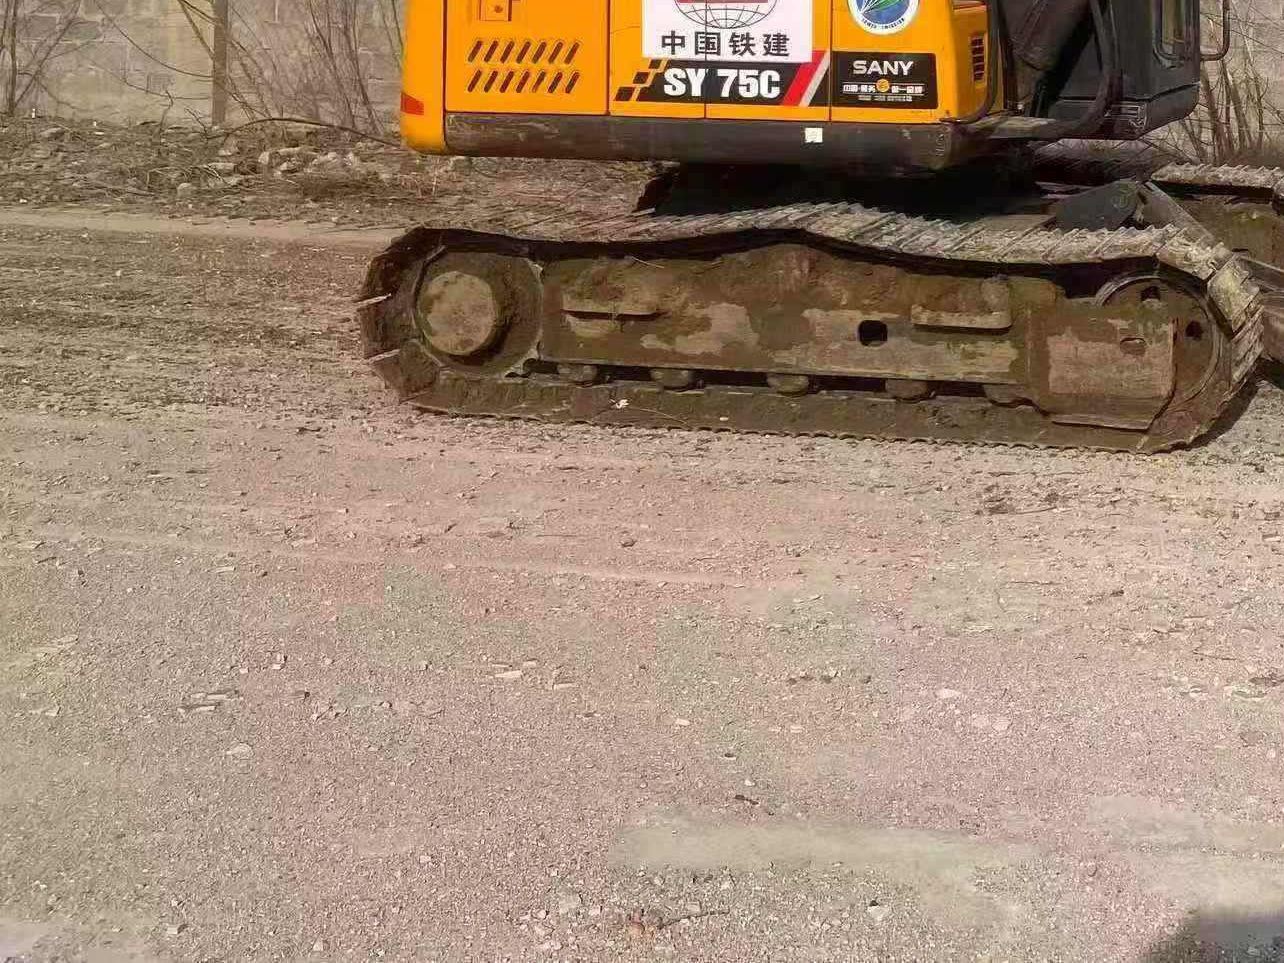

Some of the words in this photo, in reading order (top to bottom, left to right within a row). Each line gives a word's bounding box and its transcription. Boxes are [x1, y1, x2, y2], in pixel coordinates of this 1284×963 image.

[660, 30, 791, 58] 中国铁建
[852, 59, 915, 77] SANY
[663, 67, 708, 98] SY
[717, 68, 781, 100] 75C
